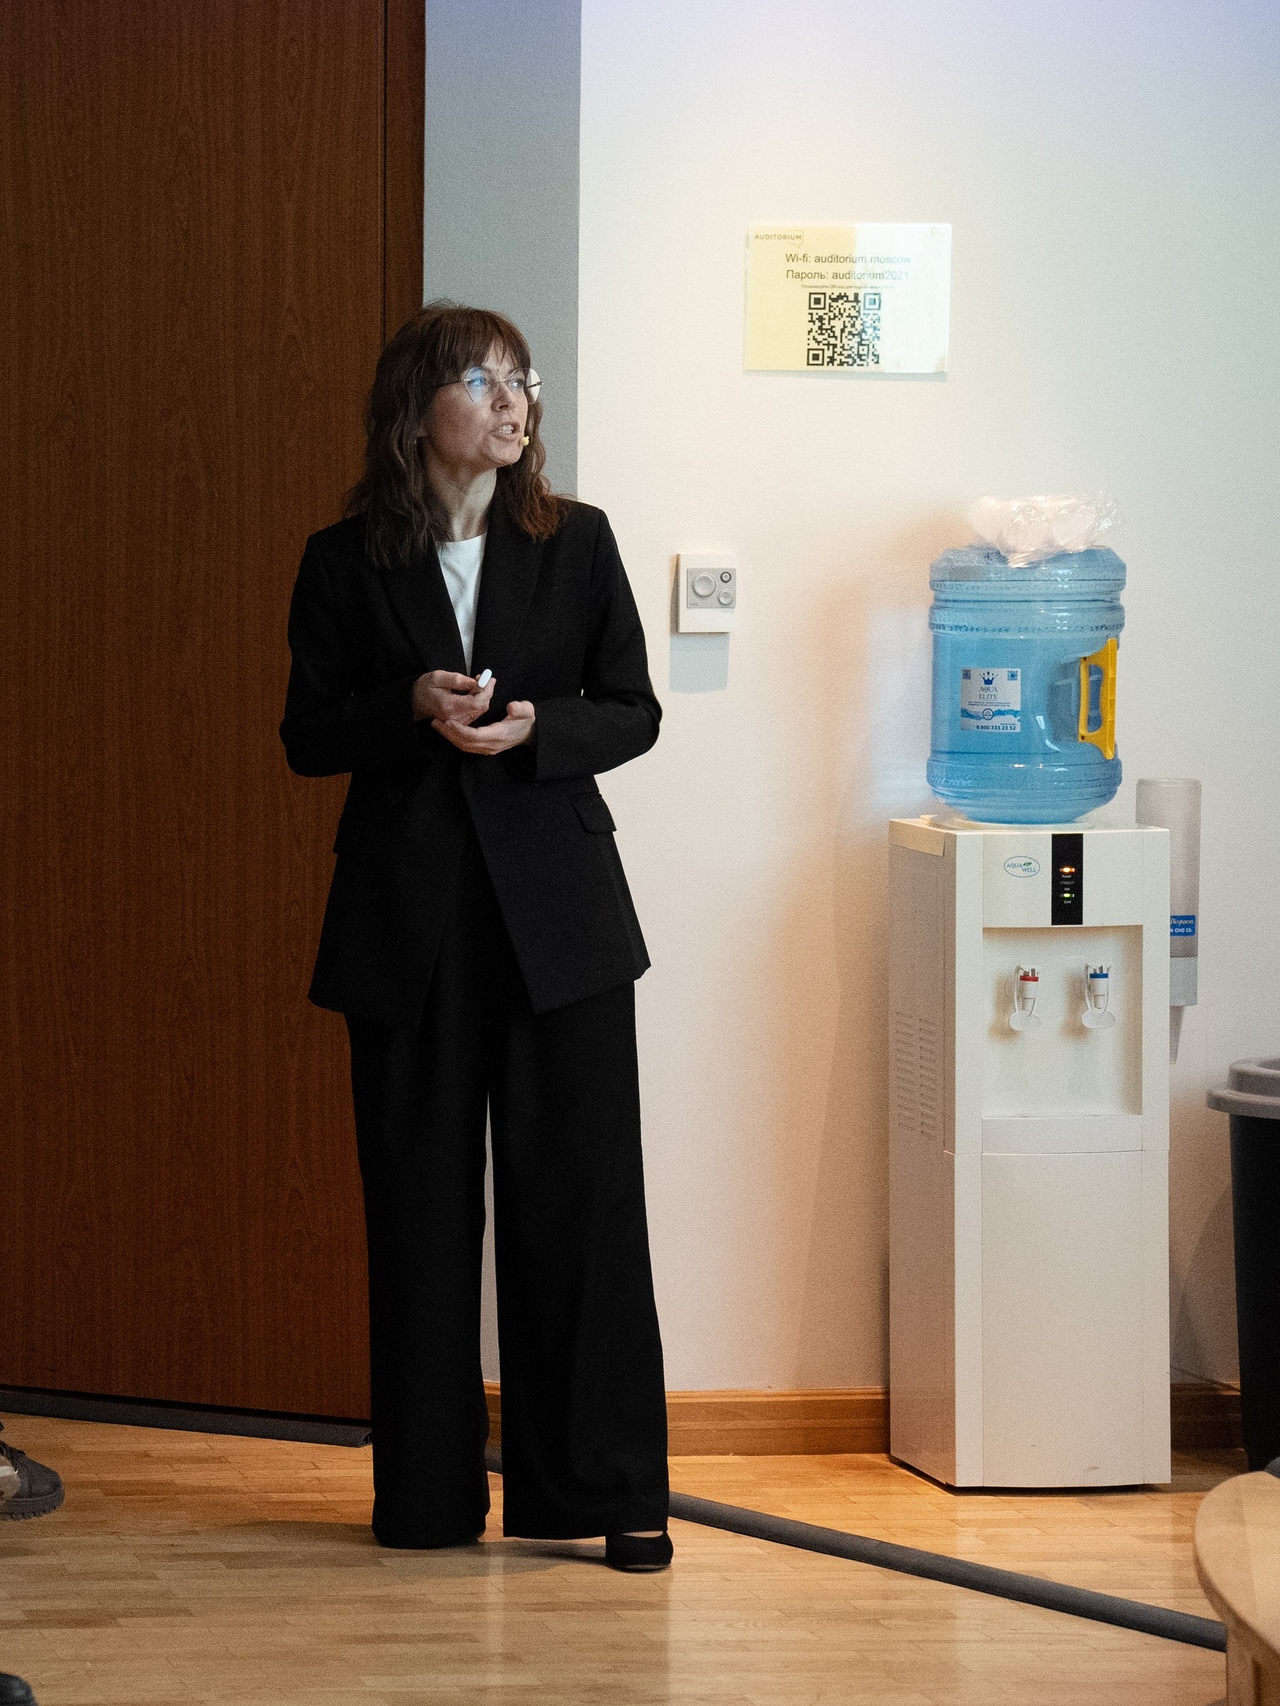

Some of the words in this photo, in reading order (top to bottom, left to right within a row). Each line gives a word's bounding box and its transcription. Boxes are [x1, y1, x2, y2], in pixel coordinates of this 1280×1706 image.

[754, 233, 802, 241] AUDITORIUM
[785, 253, 811, 263] Wi-fi:
[786, 269, 829, 281] Пароль:
